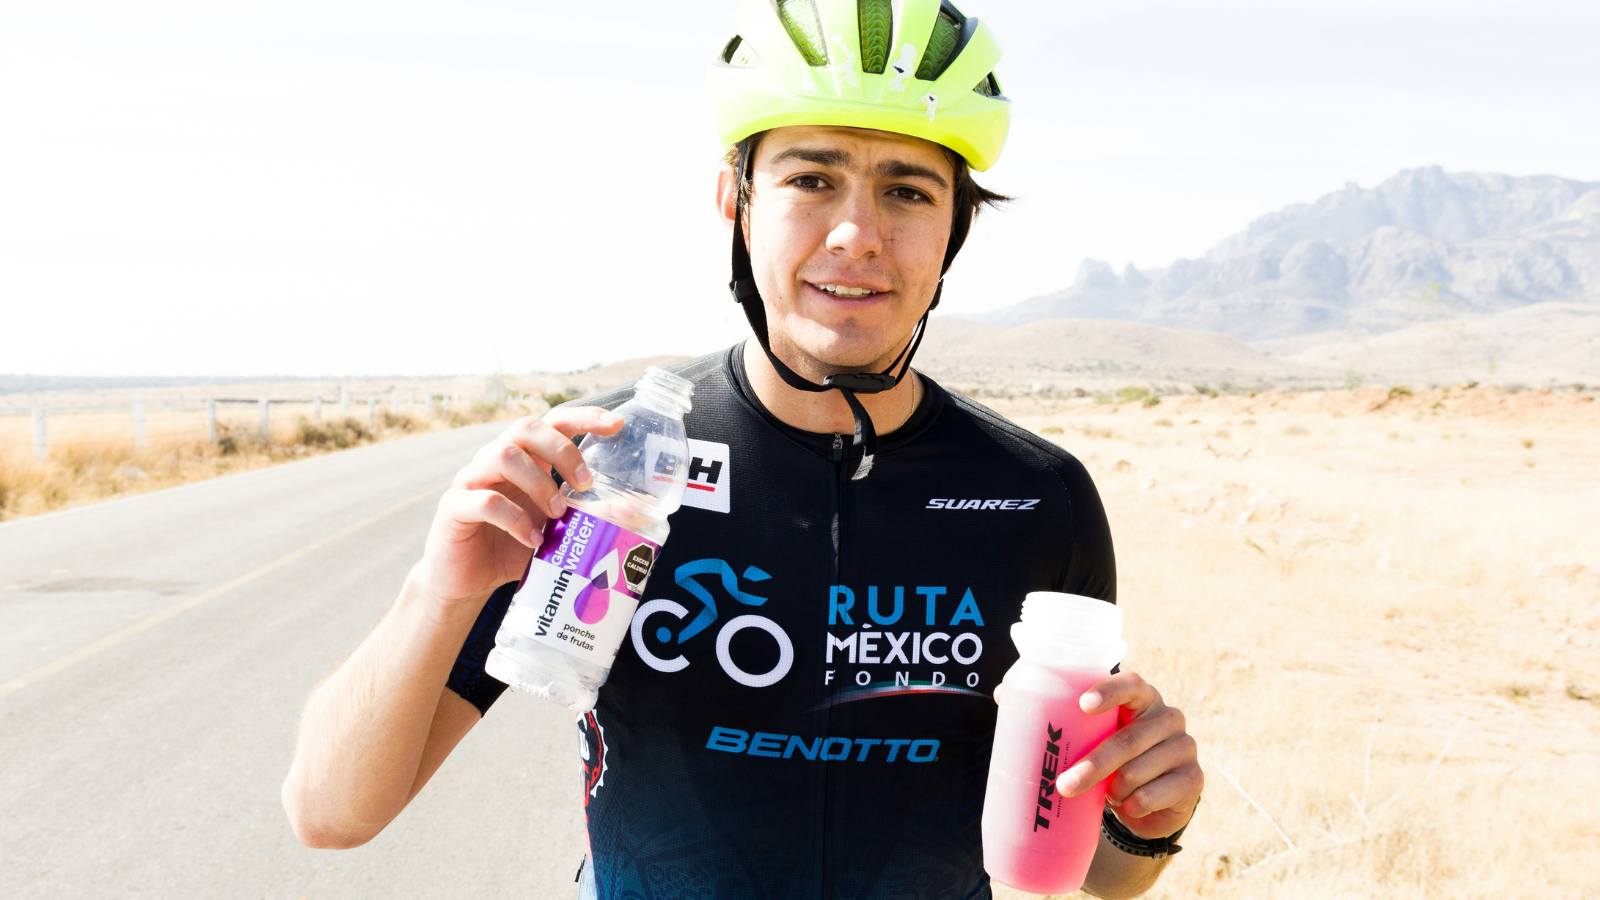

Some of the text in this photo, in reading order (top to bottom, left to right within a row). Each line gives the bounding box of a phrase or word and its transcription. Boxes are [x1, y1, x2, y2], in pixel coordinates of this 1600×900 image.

[925, 498, 1041, 510] SUAREZ
[551, 512, 581, 566] Glaceau
[828, 585, 985, 627] RUTA
[556, 631, 594, 652] de frutas
[563, 624, 596, 640] ponche
[824, 670, 980, 688] FONDO
[705, 726, 941, 763] BENOTTO
[1033, 721, 1063, 833] TREK
